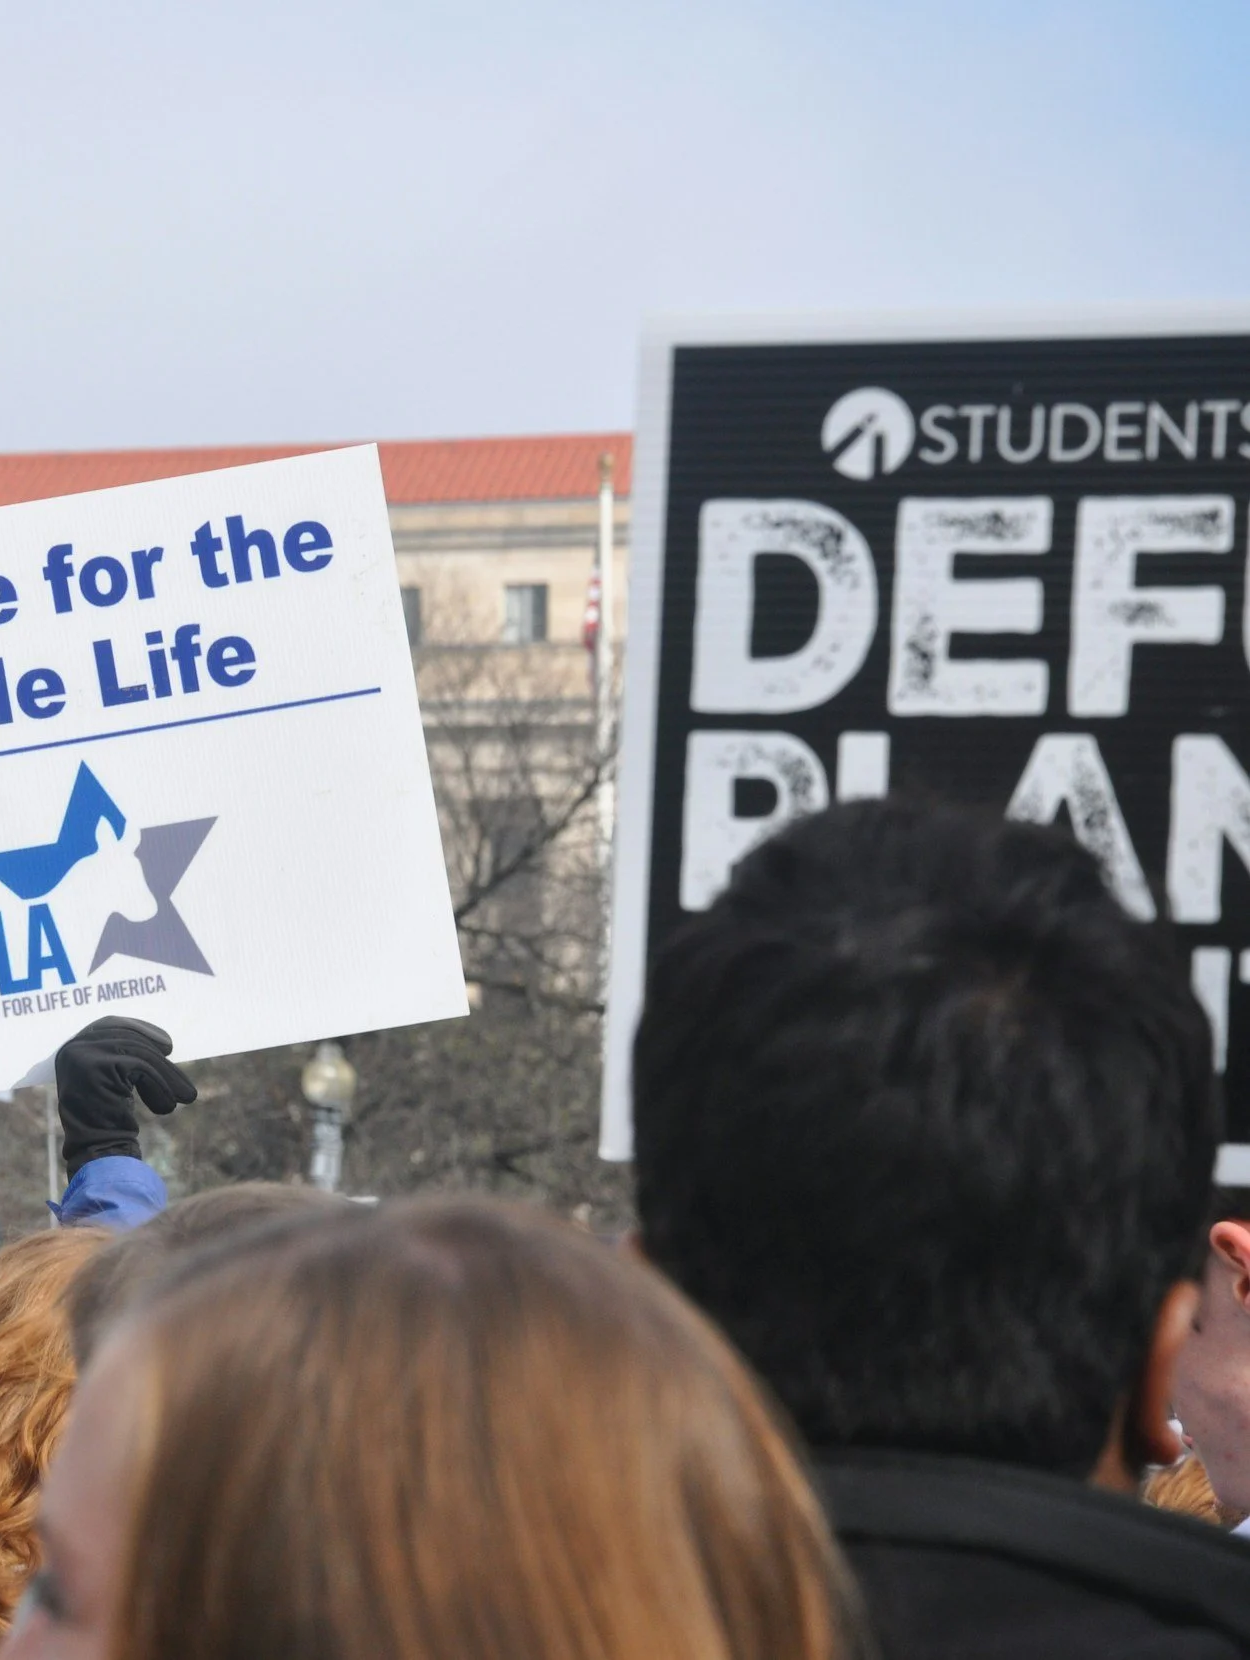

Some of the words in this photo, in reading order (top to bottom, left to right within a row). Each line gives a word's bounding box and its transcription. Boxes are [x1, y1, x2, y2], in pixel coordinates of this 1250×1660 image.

[919, 400, 1250, 464] STUDENT
[42, 543, 164, 614] for
[190, 515, 333, 589] the
[690, 494, 1250, 718] DEF
[92, 623, 256, 708] Life
[2, 996, 34, 1018] FOR
[37, 990, 70, 1012] LIFE
[72, 986, 92, 1006] OF
[97, 974, 167, 1003] AMERICA
